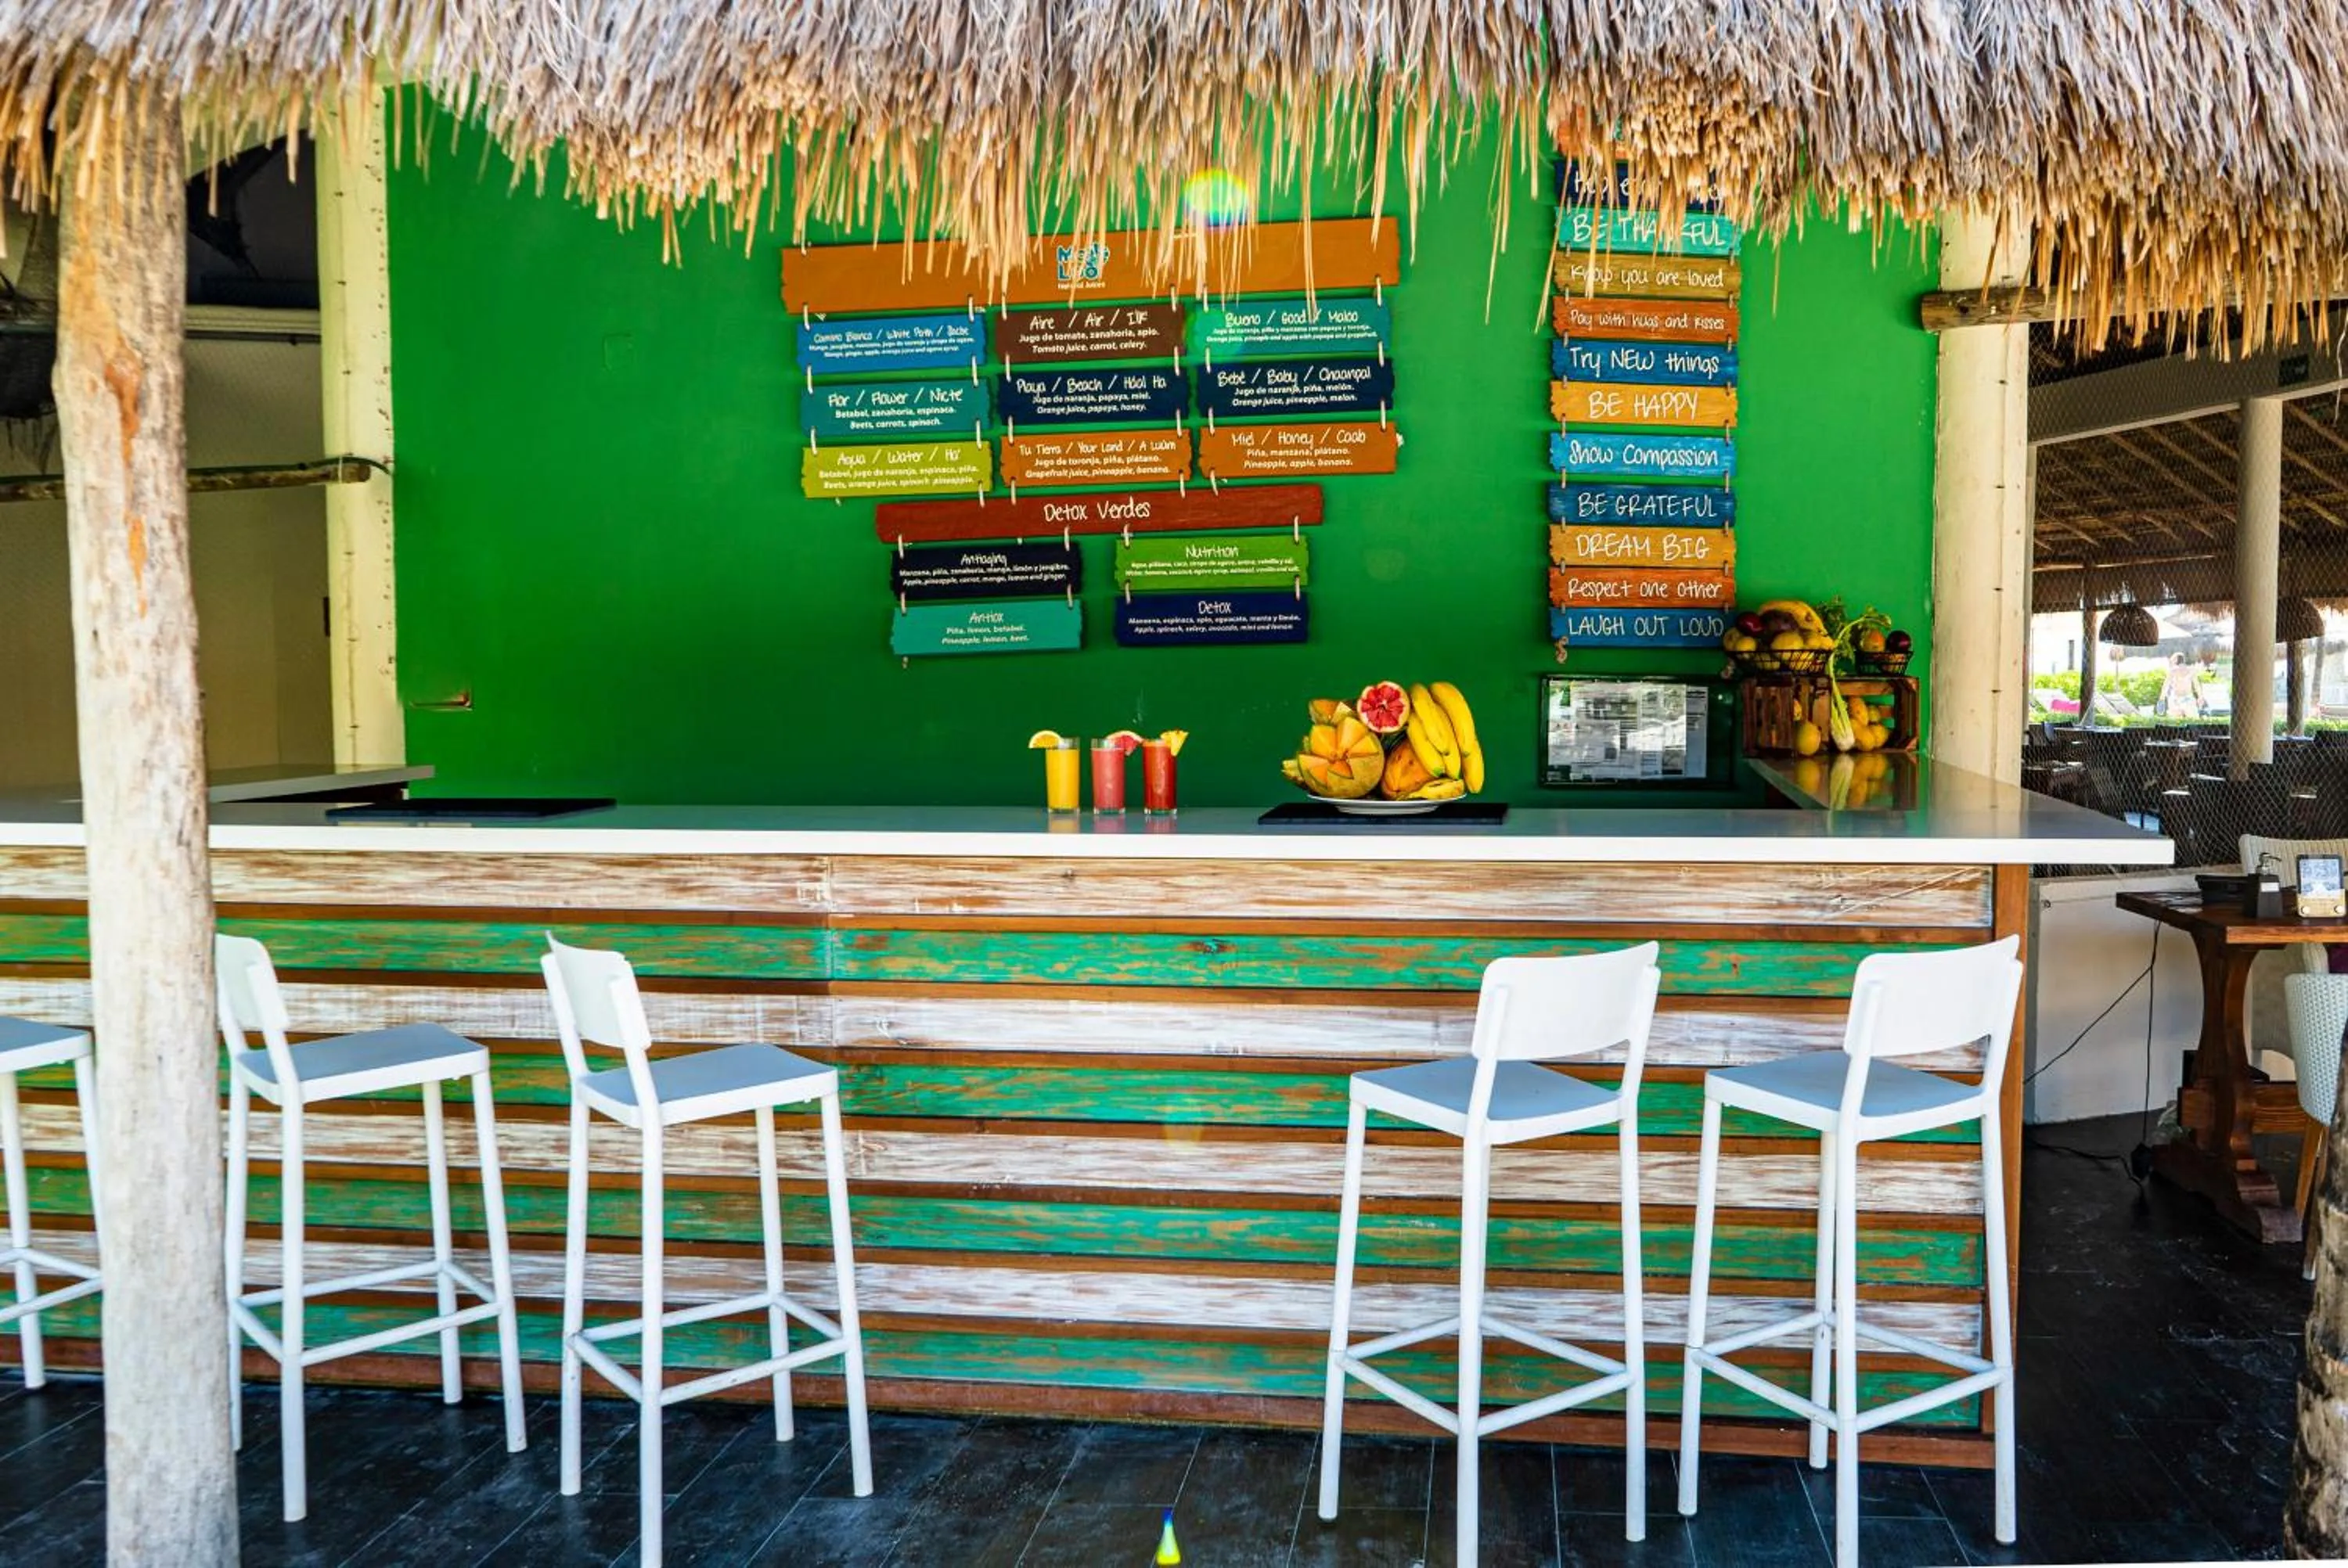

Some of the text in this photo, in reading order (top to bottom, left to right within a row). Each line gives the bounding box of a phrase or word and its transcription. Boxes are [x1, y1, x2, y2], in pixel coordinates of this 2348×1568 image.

[1574, 171, 1608, 200] Hep
[1573, 214, 1727, 246] BE THAFUL
[1622, 270, 1648, 291] you
[1656, 272, 1680, 285] are
[1687, 268, 1724, 287] loved
[1030, 315, 1055, 330] Aire
[1085, 312, 1104, 328] Air
[1225, 312, 1261, 328] Bueno
[1281, 309, 1306, 325] Good
[1570, 309, 1593, 332] Pay
[1599, 312, 1626, 326] with
[1632, 312, 1658, 332] hugs
[1665, 313, 1688, 329] and
[1042, 333, 1053, 341] de
[1569, 347, 1720, 379] Try NEW things
[1016, 378, 1046, 397] Playa
[1067, 378, 1103, 394] Beach
[1267, 369, 1298, 389] Baby
[1589, 390, 1698, 420] BE HAPPY
[1278, 431, 1314, 451] Honey
[837, 451, 866, 469] Agua
[888, 451, 924, 464] Water
[1568, 439, 1719, 471] Show Compassion
[1043, 495, 1151, 522] Detox Verdes
[1578, 491, 1718, 518] BE GRATEFUL
[1576, 533, 1710, 561] DREAM BIG
[1568, 577, 1723, 602] Respect one other
[1198, 600, 1232, 614] Detox
[1568, 614, 1724, 636] LAUGH OUT LOUD
